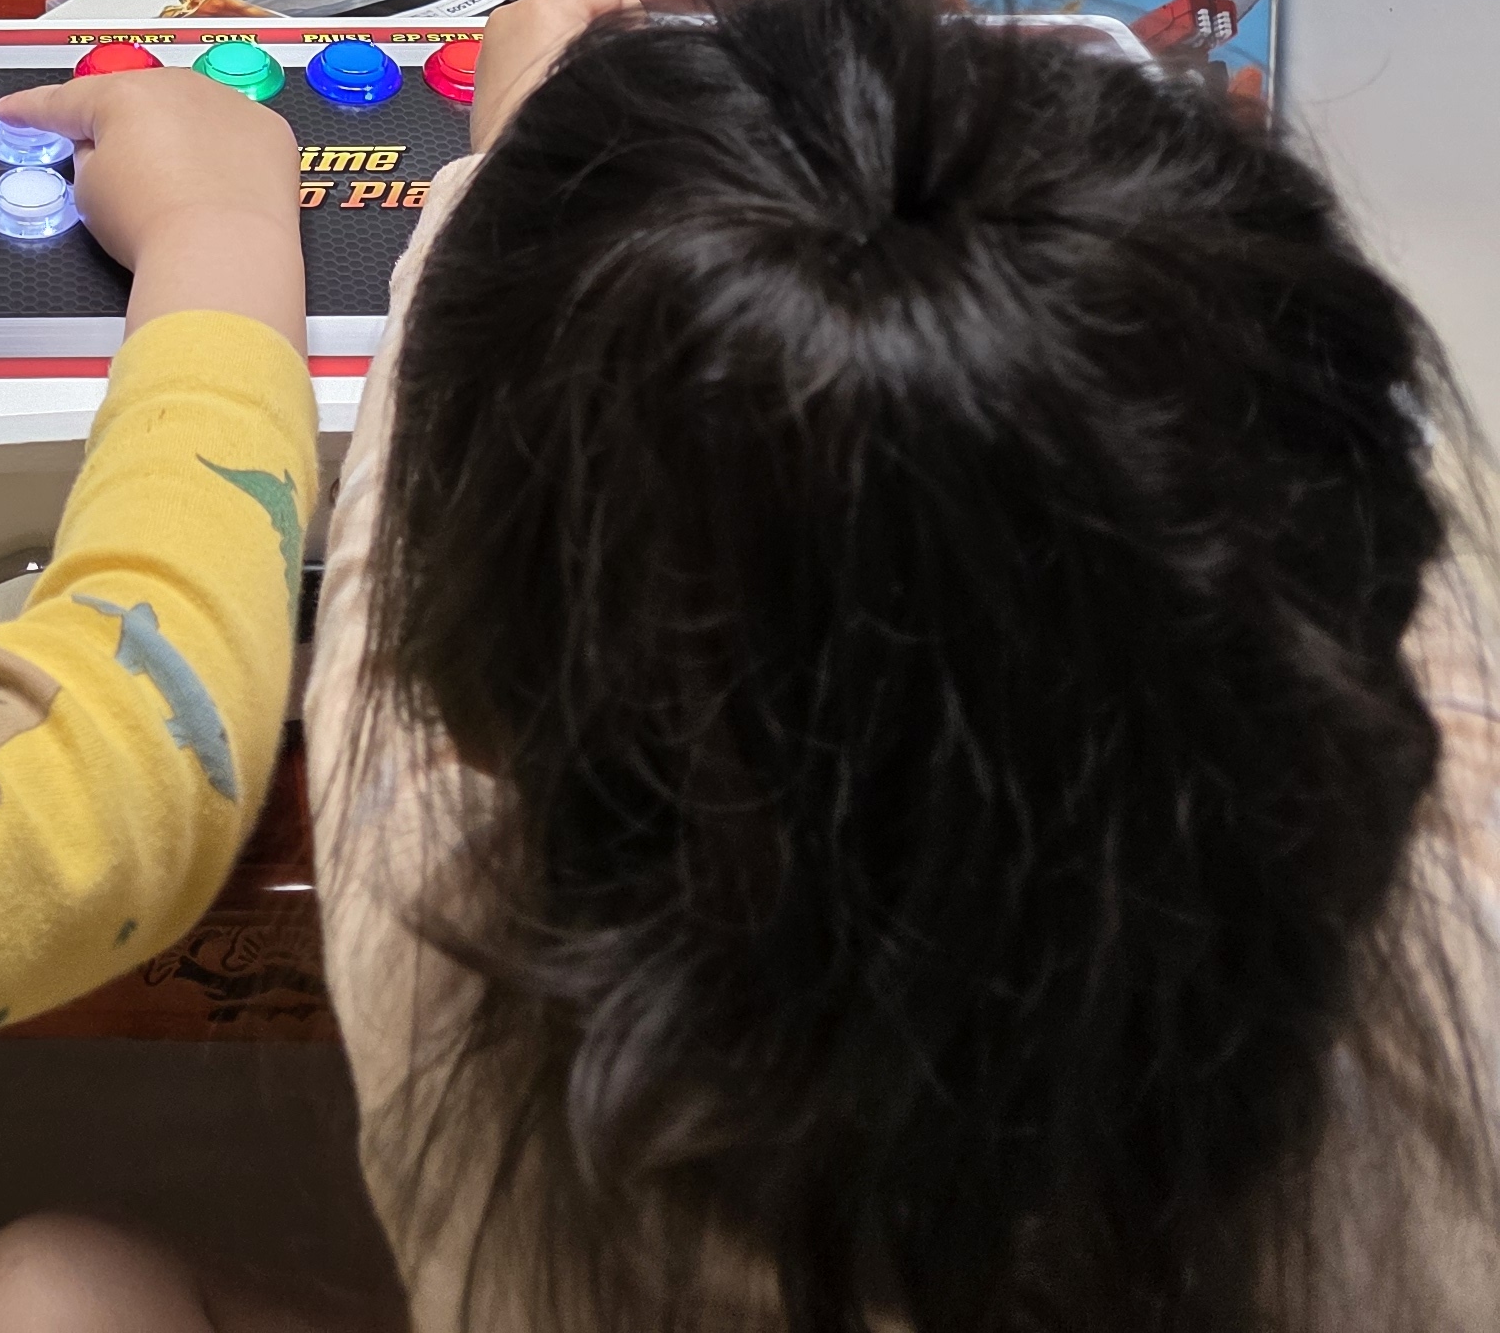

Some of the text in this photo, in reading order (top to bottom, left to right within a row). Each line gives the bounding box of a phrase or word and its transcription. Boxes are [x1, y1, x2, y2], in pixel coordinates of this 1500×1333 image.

[68, 34, 176, 45] 1P START
[201, 34, 259, 45] COIN
[303, 34, 374, 45] PAUSE
[391, 33, 484, 43] 2P STAR
[298, 145, 407, 172] ime
[300, 181, 431, 208] o Pla
